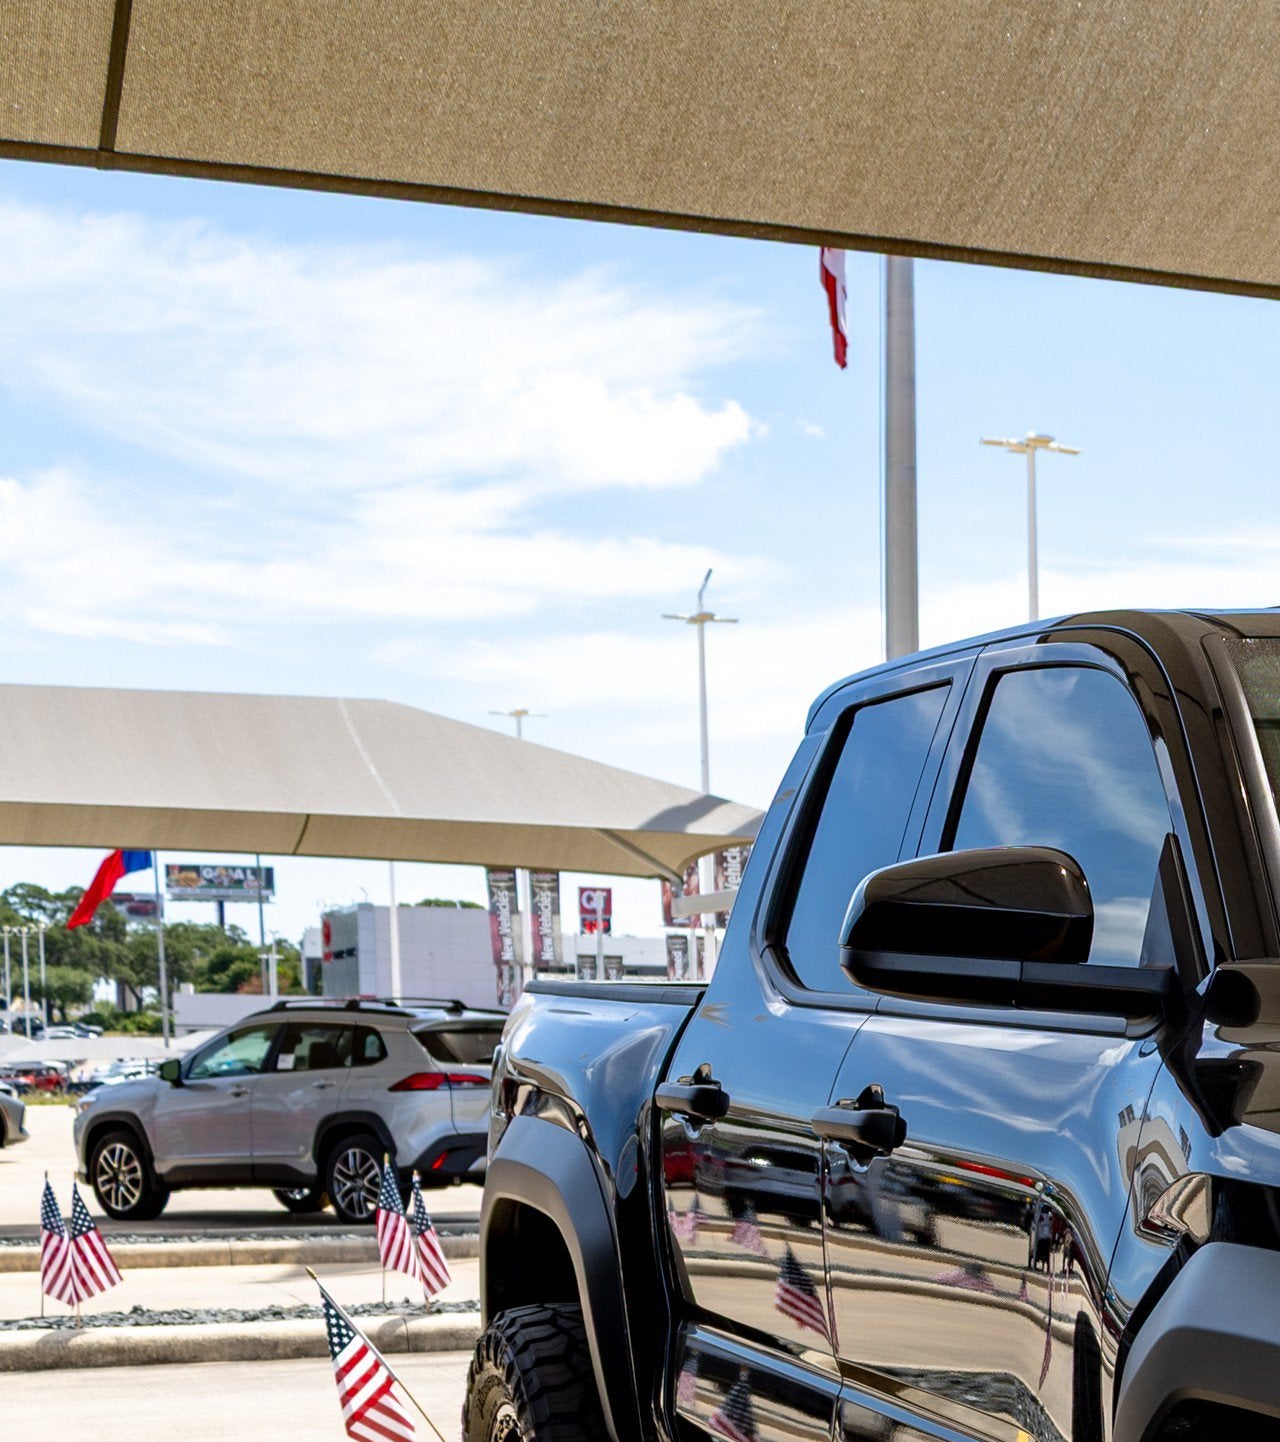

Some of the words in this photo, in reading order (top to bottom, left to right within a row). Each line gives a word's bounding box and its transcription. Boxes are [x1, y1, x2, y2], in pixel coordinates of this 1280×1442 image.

[496, 890, 512, 935] Vehicles
[537, 890, 552, 935] Vehicles
[501, 936, 515, 961] New
[539, 936, 554, 961] New
